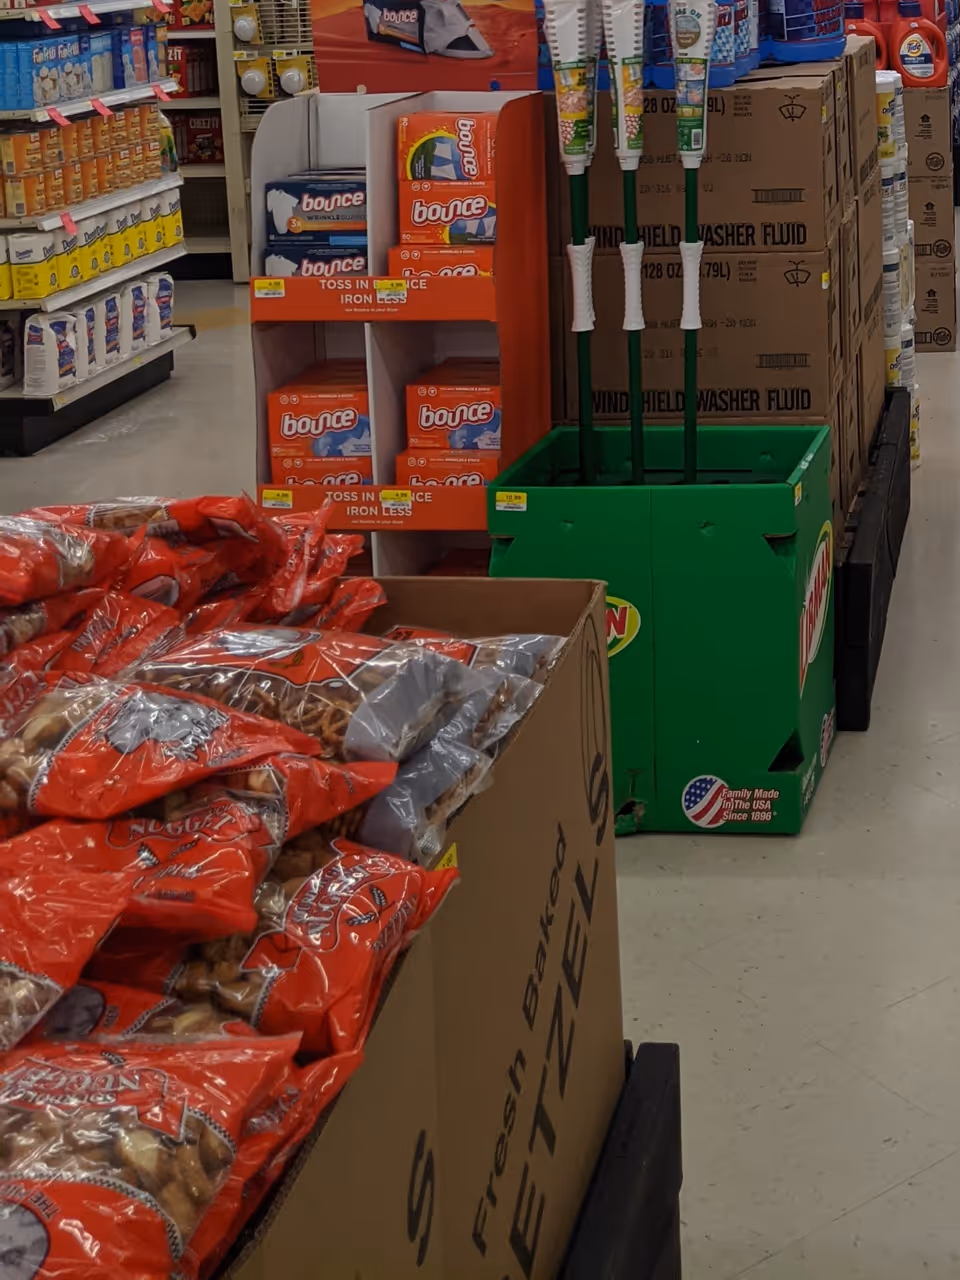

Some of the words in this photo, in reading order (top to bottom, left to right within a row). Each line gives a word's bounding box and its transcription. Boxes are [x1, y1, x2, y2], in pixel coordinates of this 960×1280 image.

[383, 8, 419, 24] bounce
[907, 43, 921, 53] Tide
[661, 97, 677, 114] OZ
[457, 118, 480, 177] bounce
[301, 191, 365, 213] bounce
[412, 196, 487, 225] bounce
[760, 221, 808, 246] FLUID
[301, 257, 366, 278] bounce
[667, 261, 682, 279] OZ
[319, 280, 352, 290] TOSS
[355, 279, 369, 290] IN
[340, 294, 373, 304] IRON
[767, 387, 812, 412] FLUID
[281, 408, 357, 439] bounce
[420, 401, 494, 430] bounce
[326, 491, 358, 503] TOSS
[361, 491, 375, 502] IN
[346, 505, 379, 517] IRON
[382, 506, 413, 517] LESS
[722, 789, 752, 800] Family
[753, 788, 780, 799] Made
[734, 800, 751, 810] The
[752, 801, 772, 810] USA
[722, 811, 748, 821] Since
[750, 811, 772, 821] 1896
[502, 752, 610, 1280] ETZELS
[471, 1048, 528, 1257] Fresh
[522, 820, 568, 1032] Baked
